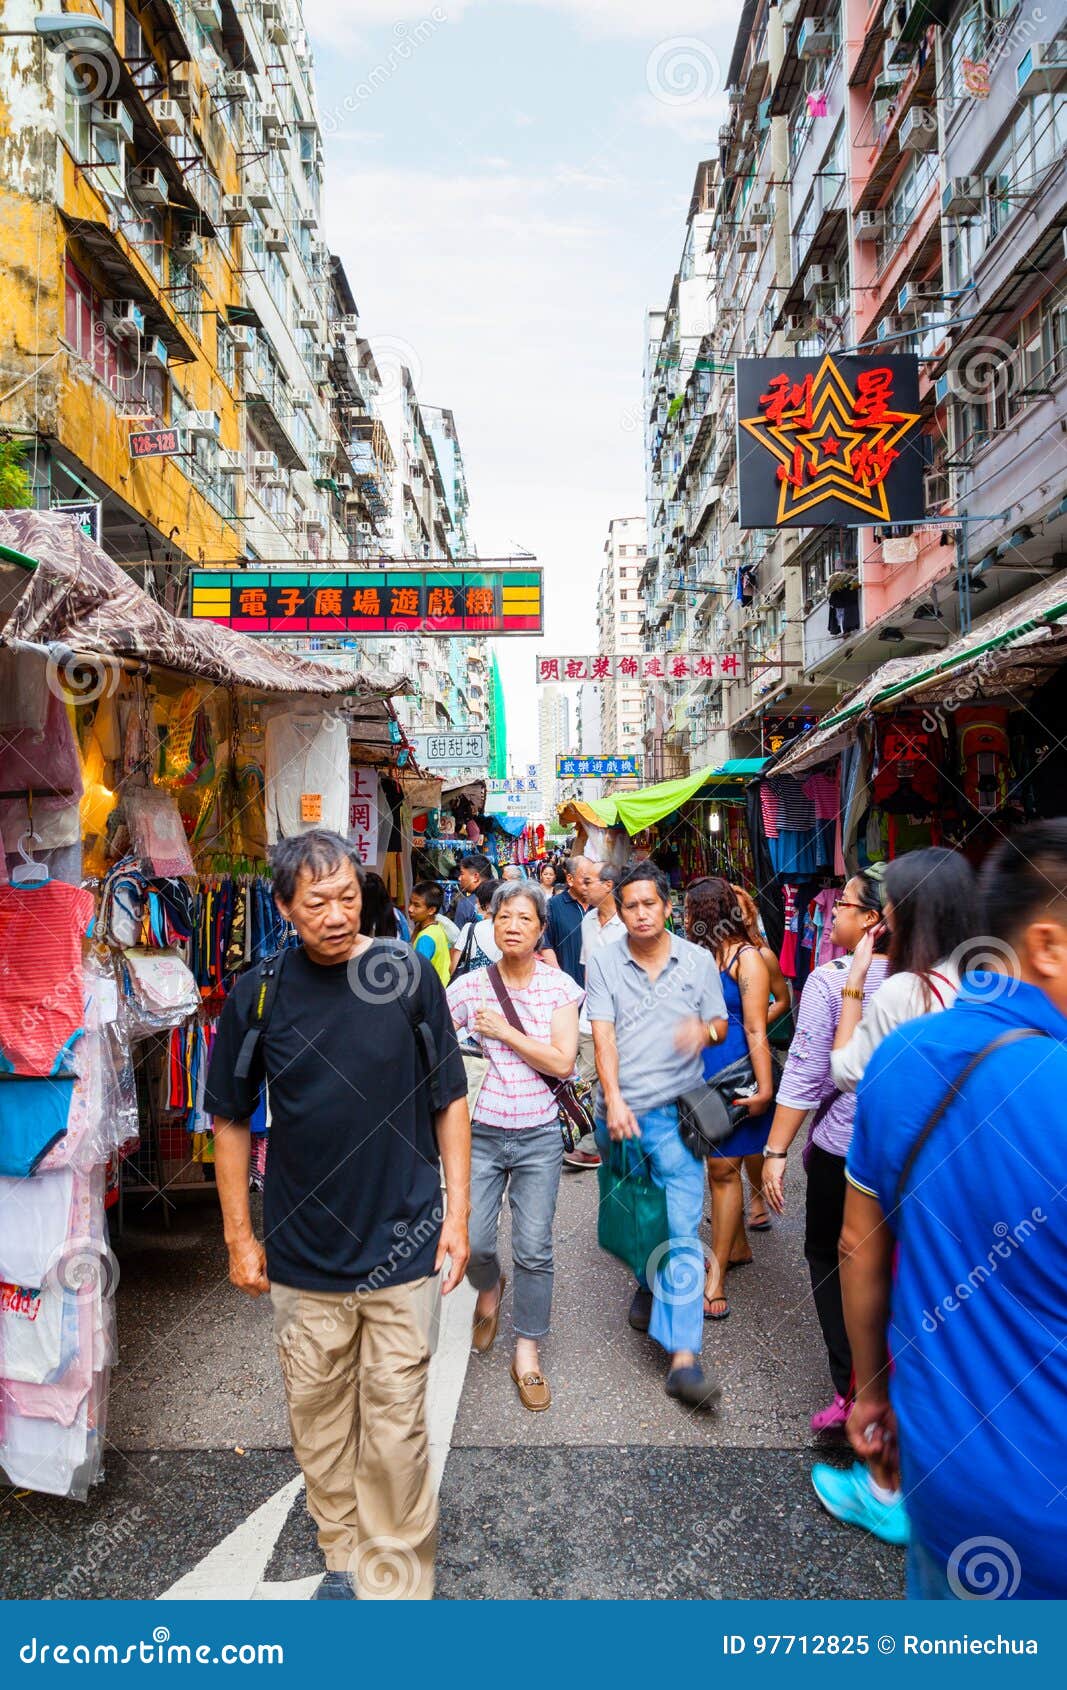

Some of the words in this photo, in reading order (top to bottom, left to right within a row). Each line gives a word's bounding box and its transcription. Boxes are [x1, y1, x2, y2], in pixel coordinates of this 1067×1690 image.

[239, 588, 493, 617] 電子廣場遊戲機
